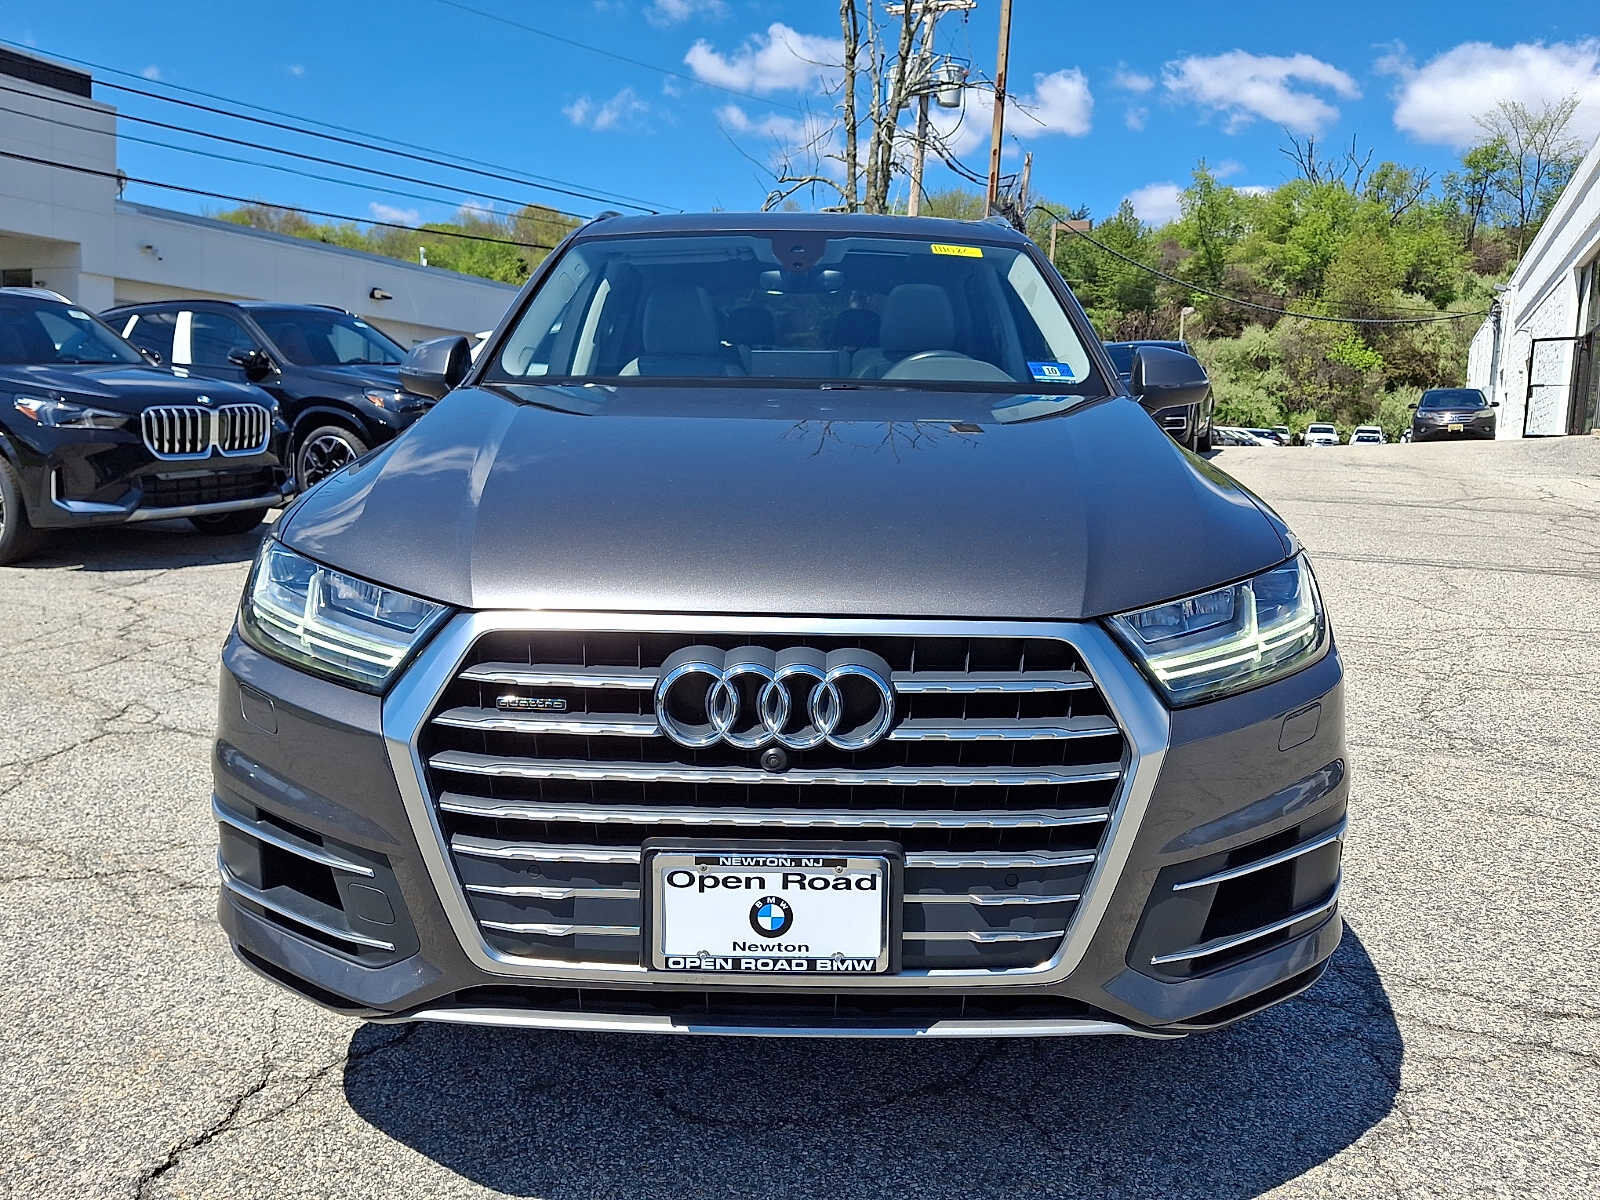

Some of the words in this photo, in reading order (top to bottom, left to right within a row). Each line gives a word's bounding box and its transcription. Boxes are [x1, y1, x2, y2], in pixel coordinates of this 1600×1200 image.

[719, 856, 796, 867] NEWTON,
[802, 858, 823, 867] NJ
[666, 870, 766, 893] Open
[782, 872, 877, 891] Road
[754, 896, 789, 910] BMW
[732, 941, 810, 953] Newton
[667, 957, 737, 970] OPEN
[740, 958, 808, 971] ROAD
[815, 959, 875, 971] BMW
